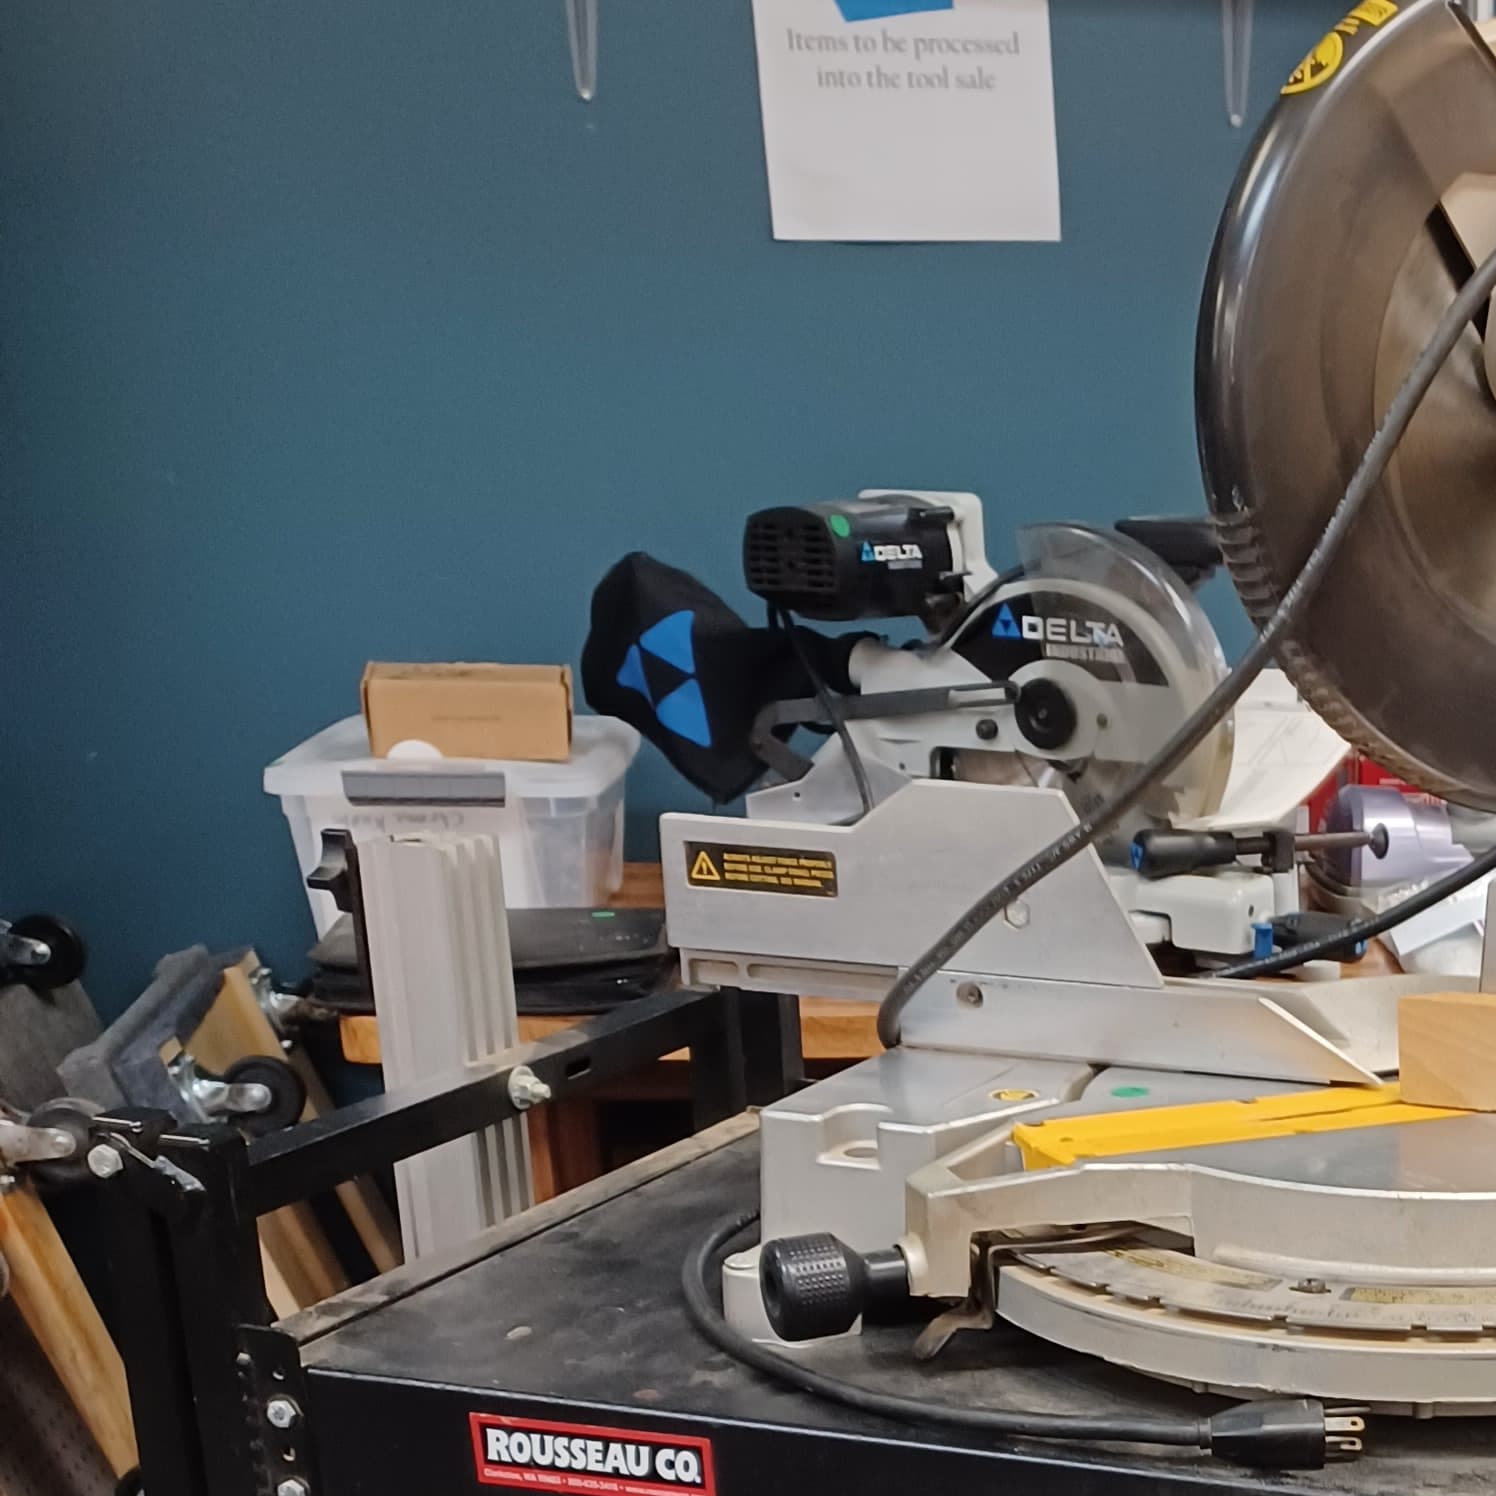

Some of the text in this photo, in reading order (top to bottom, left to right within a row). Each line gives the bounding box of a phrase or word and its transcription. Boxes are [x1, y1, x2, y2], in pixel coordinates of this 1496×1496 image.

[786, 28, 1020, 61] Items to be processed
[817, 64, 997, 90] into the tool sale
[873, 543, 924, 562] DELTA
[1020, 614, 1125, 648] DELTA
[485, 1427, 702, 1484] ROUSSEAU CO.
